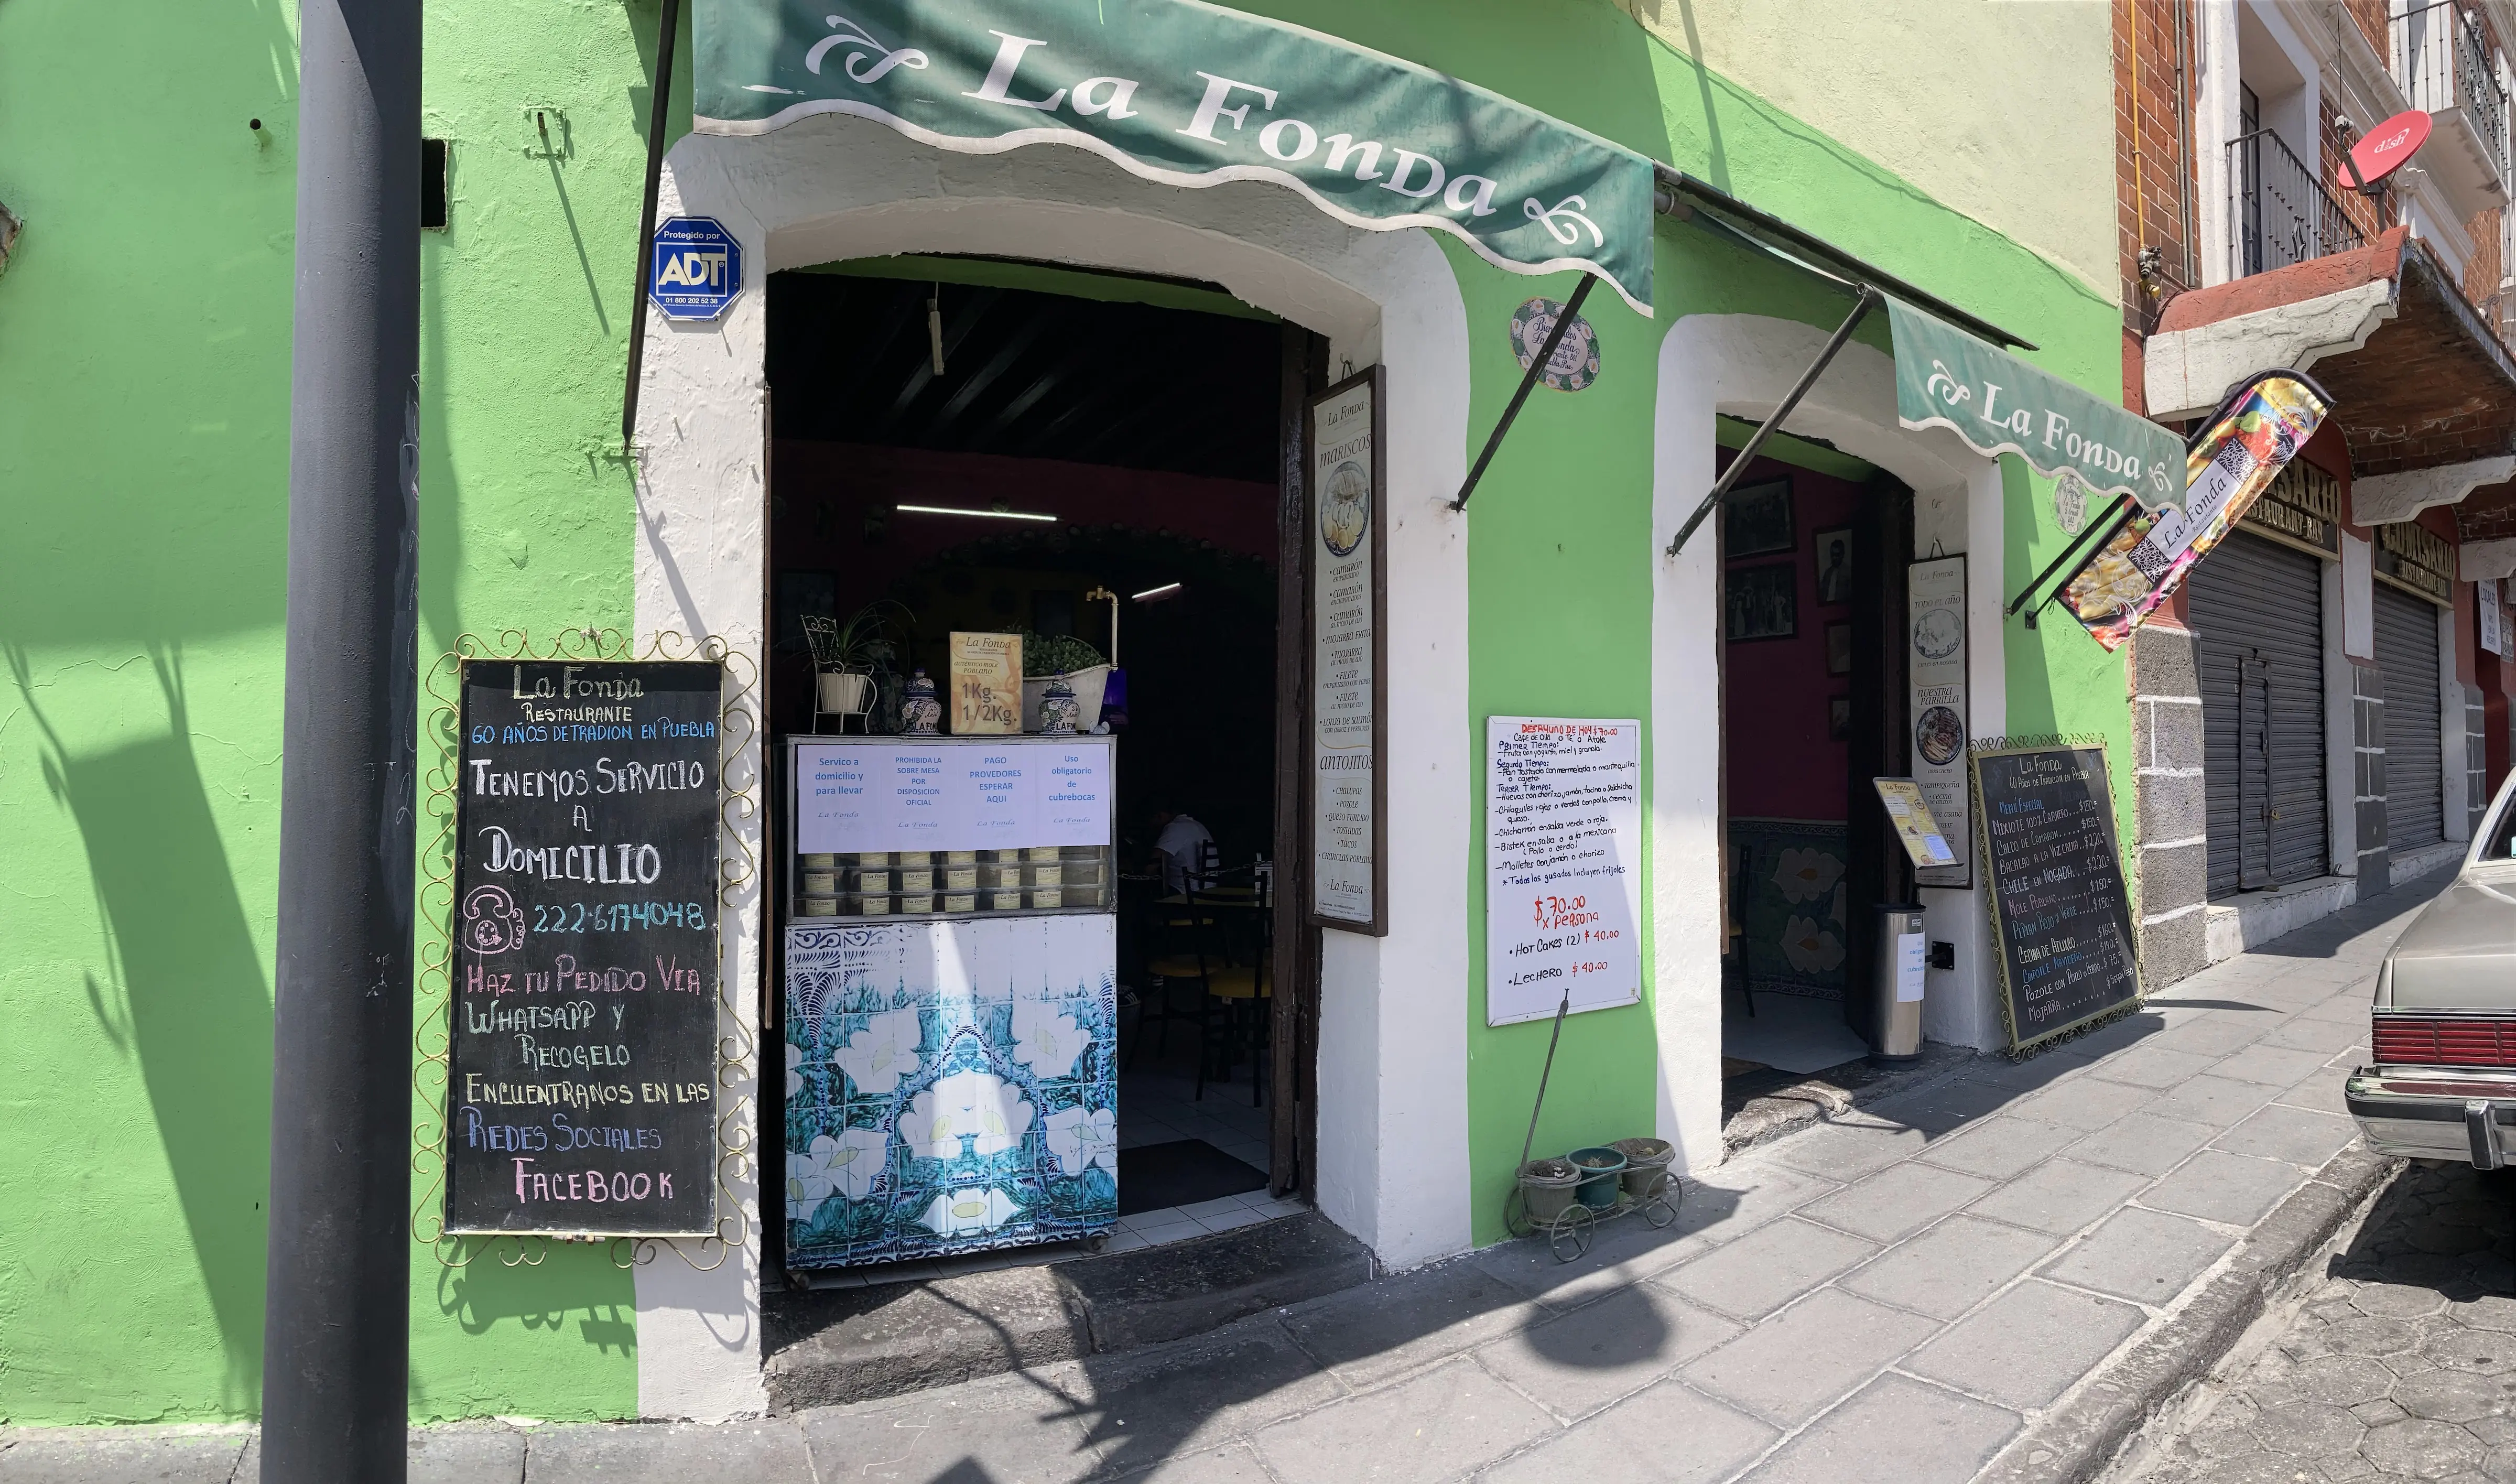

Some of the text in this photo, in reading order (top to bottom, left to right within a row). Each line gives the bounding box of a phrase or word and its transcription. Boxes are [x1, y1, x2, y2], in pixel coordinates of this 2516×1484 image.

[961, 29, 1499, 220] La Fonda
[2374, 132, 2406, 154] dish
[664, 231, 704, 240] Protegido
[658, 253, 726, 286] ADT
[1557, 340, 1579, 355] onda
[1328, 402, 1364, 426] La Fonda
[1979, 381, 2141, 481] La Fonda
[2165, 478, 2227, 549] La Fonda
[2192, 505, 2217, 533] Restaurante
[967, 637, 1011, 648] La Fonda
[512, 665, 556, 699] La
[521, 702, 632, 723] RESTAURANTE
[471, 716, 714, 744] 60 AÑOS DE TRADION EN PUEBLA
[1522, 724, 1563, 734] DESAYUNO
[1566, 724, 1576, 734] DE
[1579, 725, 1591, 734] HOY
[1588, 734, 1606, 743] Atole
[1497, 759, 1522, 768] Segundo
[2019, 757, 2033, 774] La
[469, 757, 704, 801] TENEMOS SERVICIO
[2009, 777, 2016, 789] 60
[2033, 778, 2038, 786] DE
[2038, 774, 2063, 786] TRADICION
[2065, 775, 2070, 783] EN
[2072, 767, 2089, 781] PUEBLA
[2019, 797, 2044, 814] ESPECIAL
[572, 805, 592, 831] A
[1992, 819, 2024, 836] MIXIOTE
[2026, 816, 2042, 828] 100%
[479, 826, 660, 884] DOMICILIO
[1547, 853, 1568, 866] jamón
[1579, 849, 1604, 859] chorizo
[1531, 873, 1541, 883] los
[1545, 868, 1571, 883] gusados
[1602, 865, 1625, 874] frijoles
[1330, 879, 1363, 894] La Fonda
[534, 901, 706, 933] 222-6174048
[2008, 900, 2027, 918] MOLE
[1567, 933, 1580, 946] (2)
[2018, 946, 2042, 964] CECINA
[2042, 946, 2051, 958] DE
[467, 954, 700, 995] HAZ TU PEDIDO VIA
[2023, 963, 2050, 984] CHIPOTLE
[465, 1000, 624, 1034] WHATSAPP Y
[514, 1033, 631, 1070] RECOGELO
[465, 1073, 709, 1112] ENCUENTRANOS EN LAS
[460, 1106, 661, 1153] REDES SOCIALES
[511, 1157, 673, 1203] FACEBOOK
